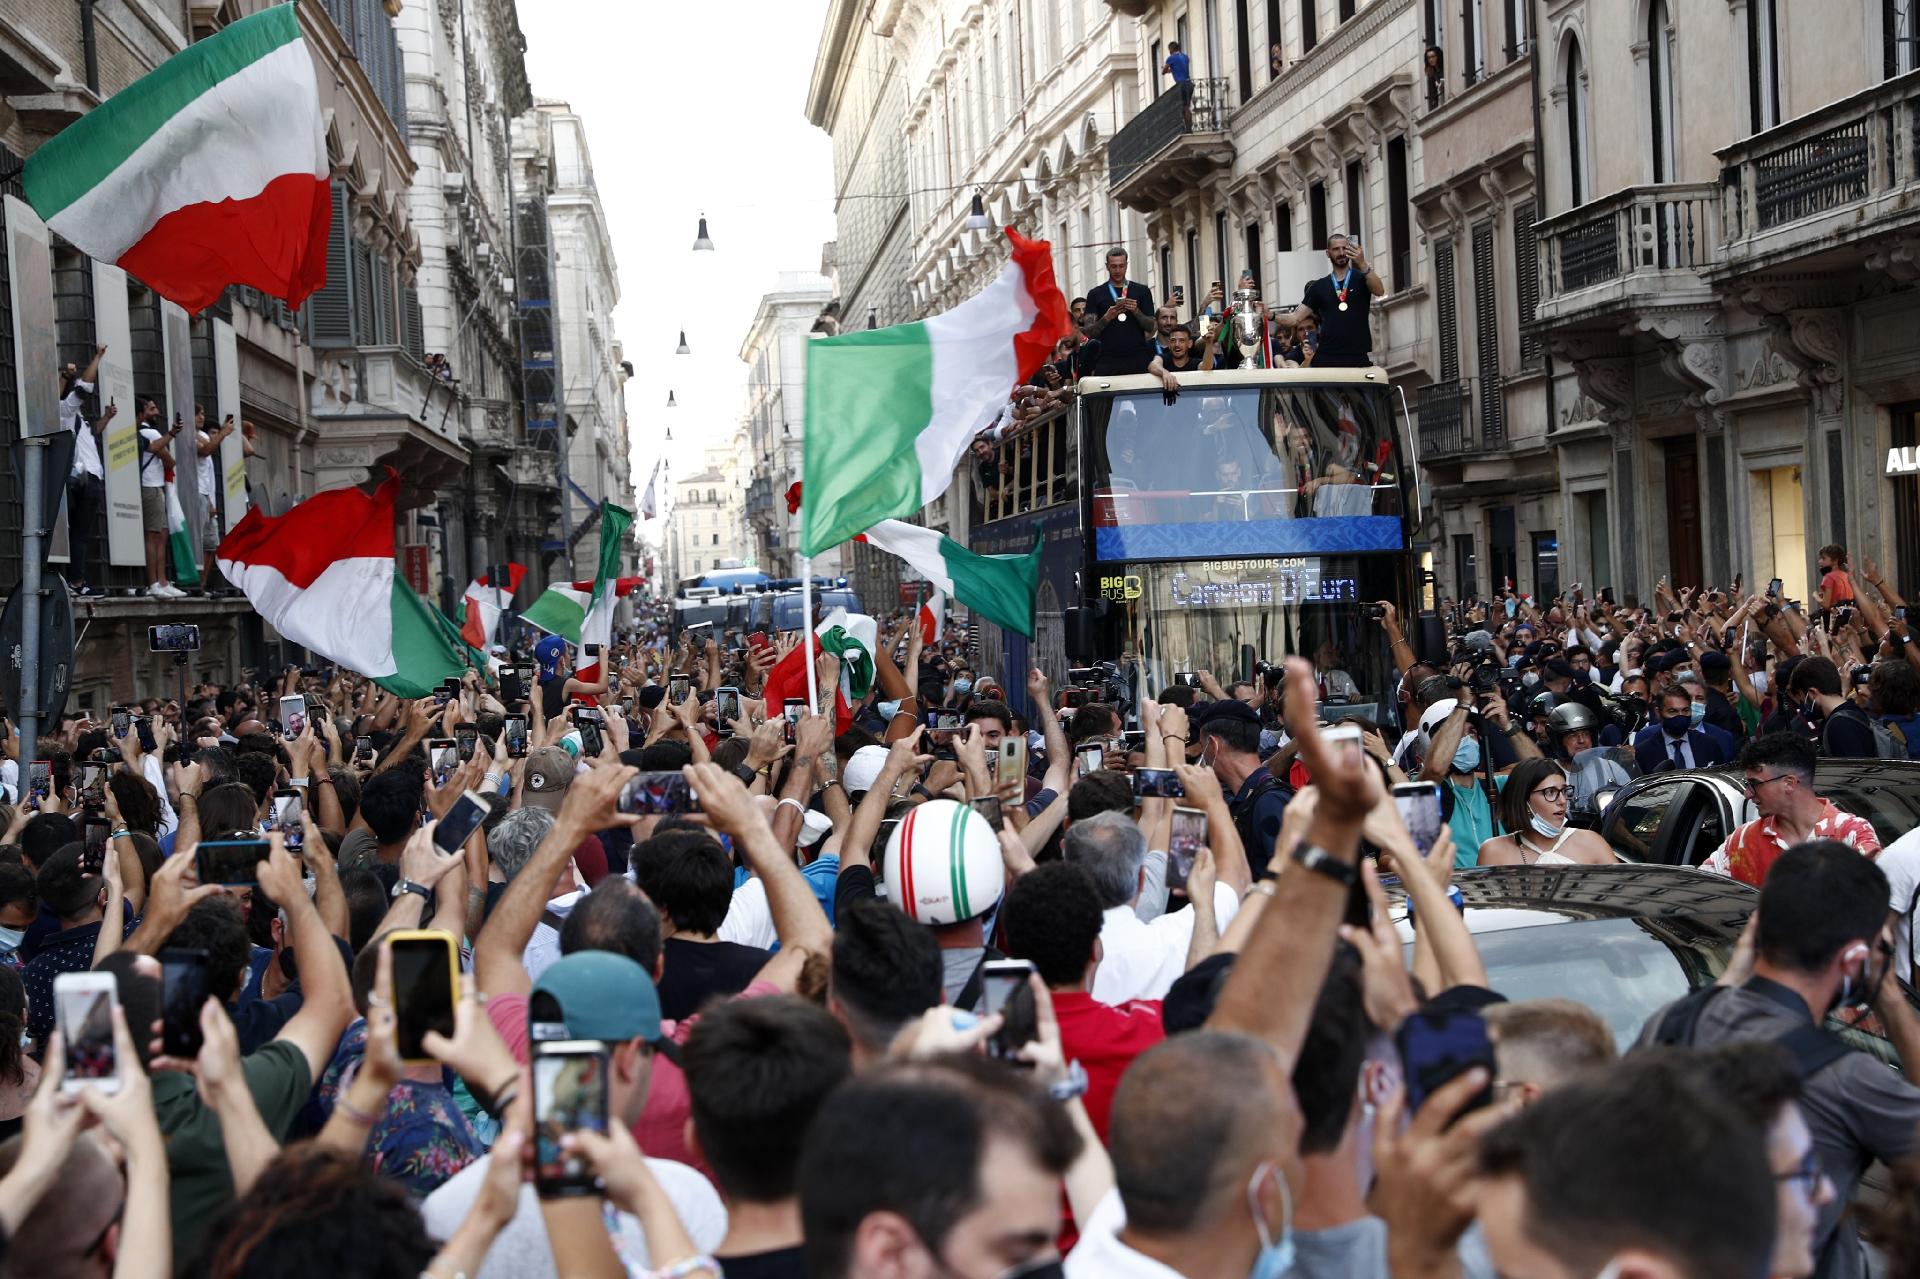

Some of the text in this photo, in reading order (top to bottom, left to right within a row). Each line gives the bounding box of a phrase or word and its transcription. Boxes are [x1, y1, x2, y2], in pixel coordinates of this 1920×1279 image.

[1203, 557, 1306, 571] BIGBUSTOURS.COM
[1100, 576, 1124, 589] BIG
[1100, 588, 1124, 601] BUS
